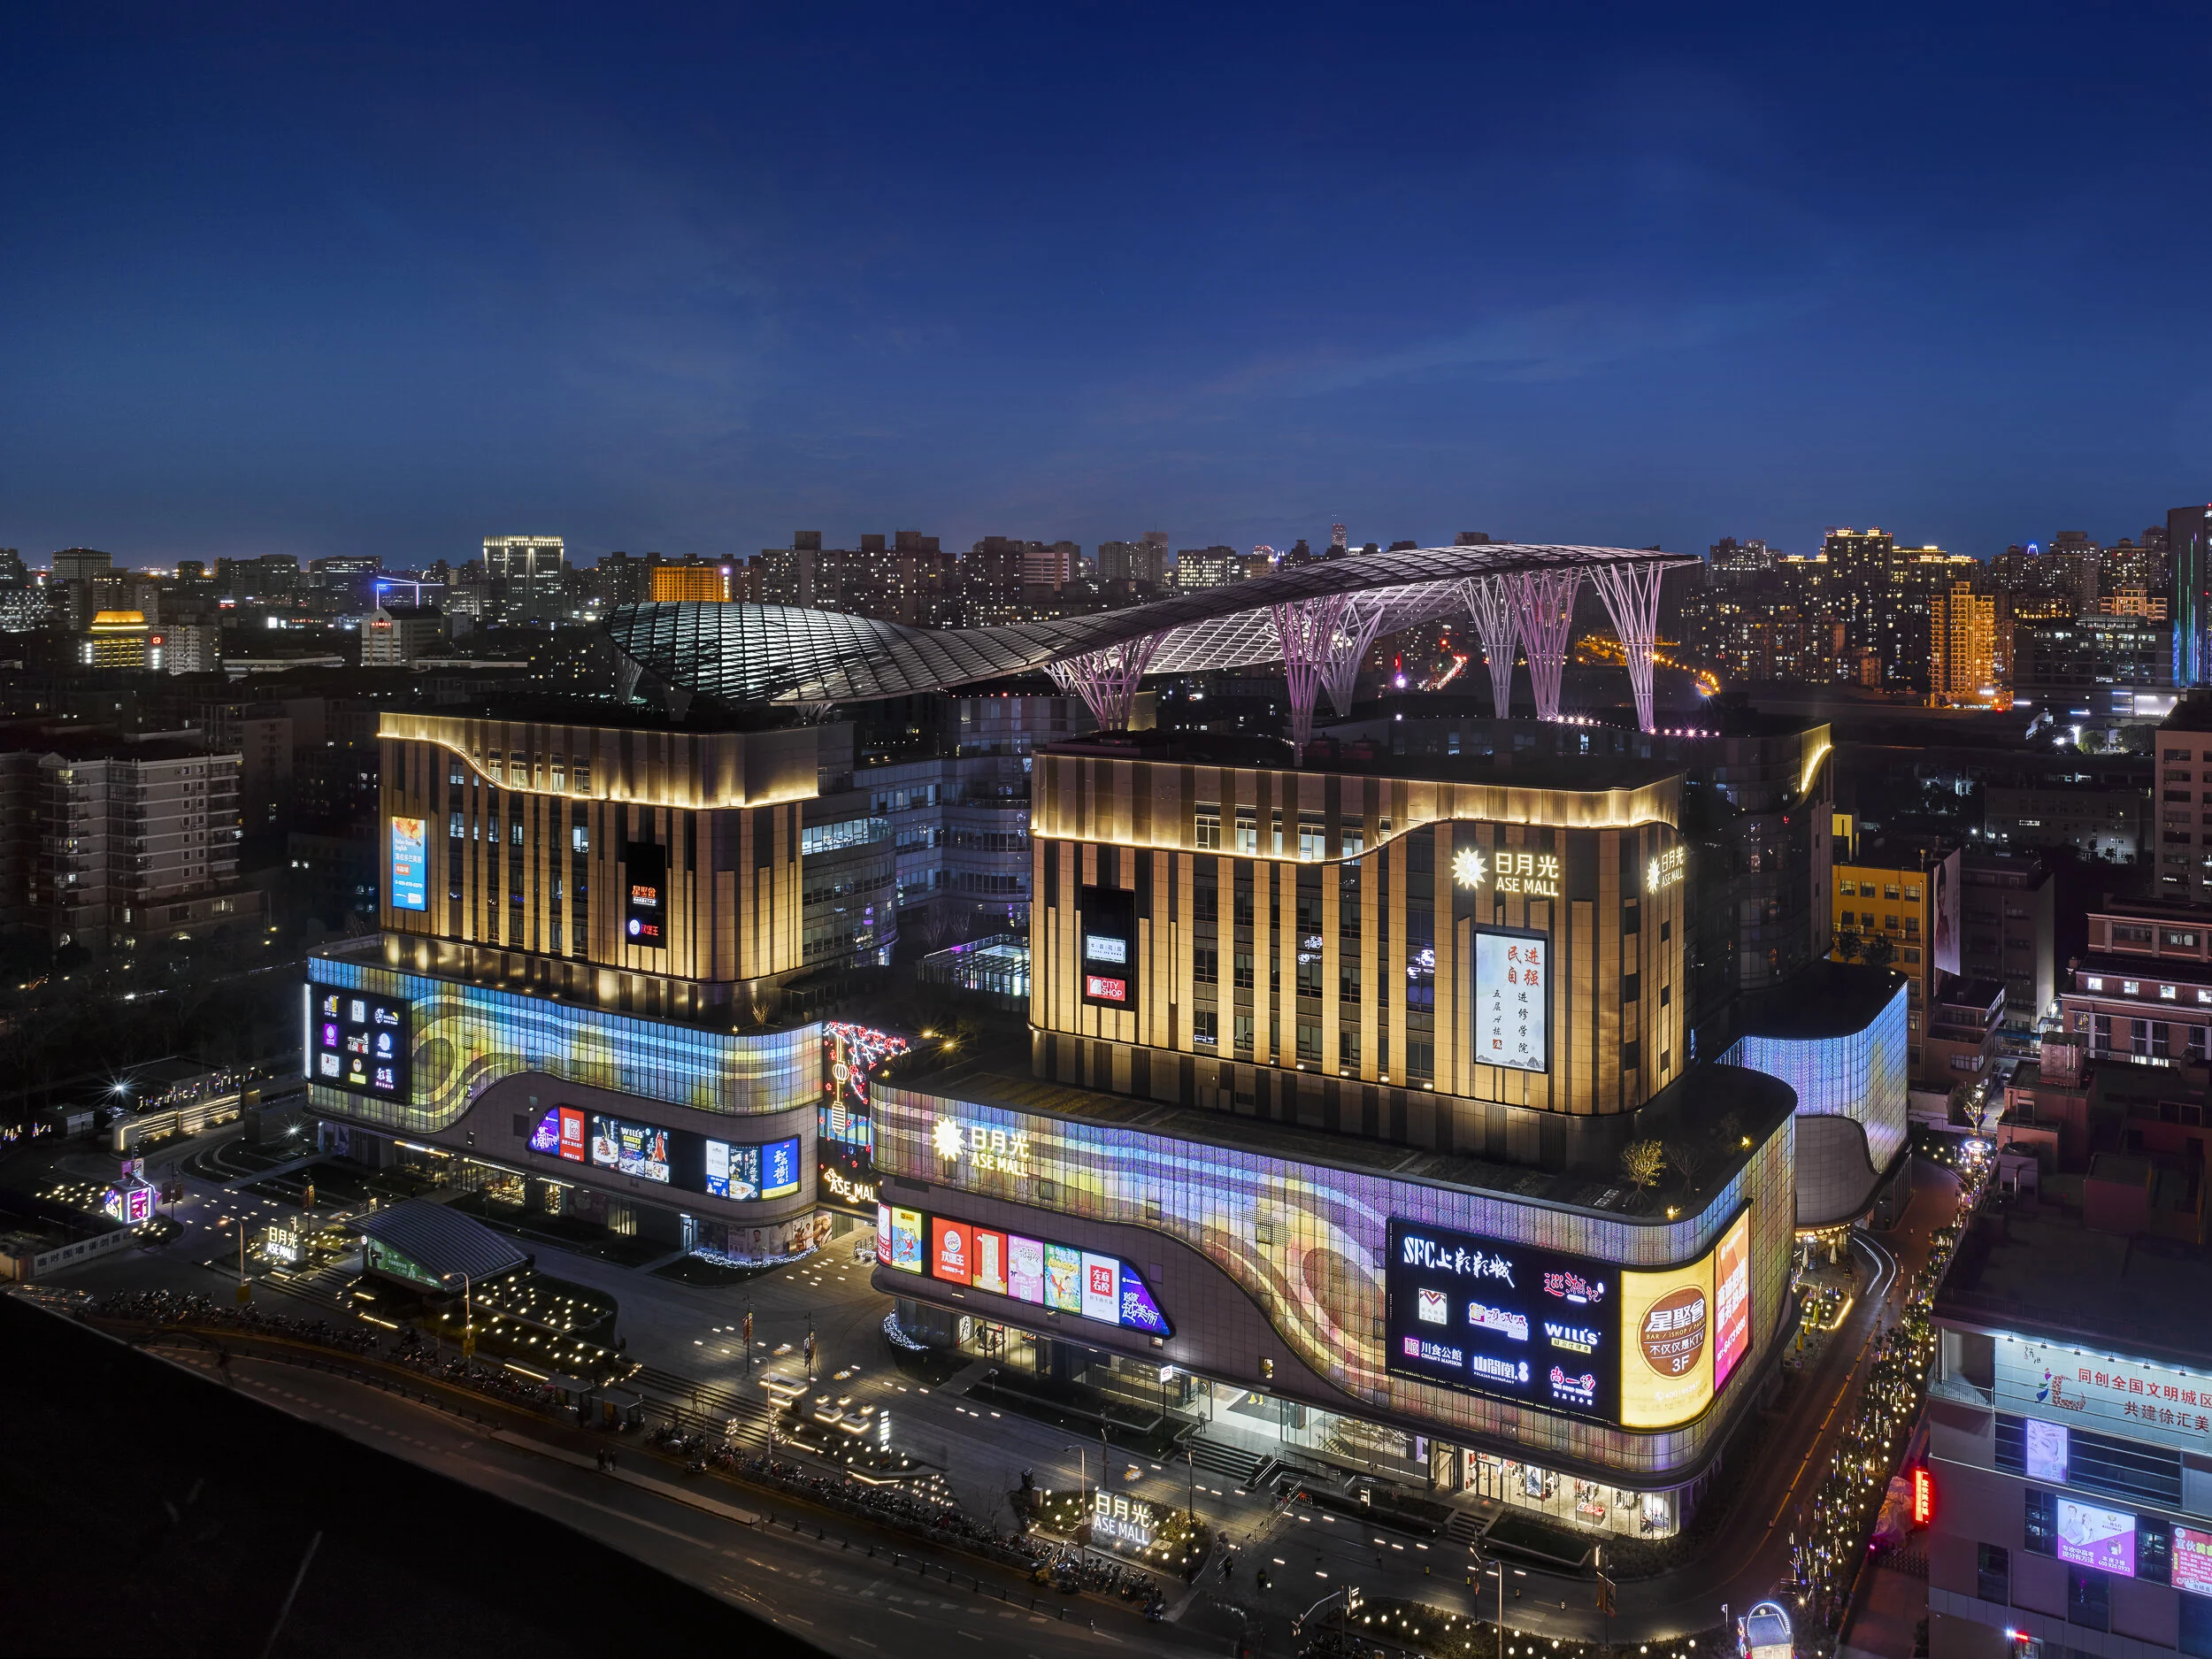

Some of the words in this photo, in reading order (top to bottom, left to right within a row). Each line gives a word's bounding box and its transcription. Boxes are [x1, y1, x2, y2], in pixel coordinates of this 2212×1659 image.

[1496, 853, 1558, 878] 日月光
[1662, 847, 1684, 872] 日月光
[1496, 878, 1519, 892] ASE
[1524, 879, 1558, 896] MALL
[1662, 872, 1671, 887] ASE
[1671, 867, 1683, 884] MALL
[1101, 979, 1119, 990] CITY
[1101, 988, 1123, 998] SHOP
[1517, 992, 1529, 1054] 进修学院
[971, 1125, 1029, 1158] 日月光
[972, 1152, 995, 1170] ASE
[997, 1157, 1029, 1178] MALL
[829, 1178, 851, 1195] ASE
[854, 1184, 879, 1202] MAL
[269, 1226, 298, 1248] 日月光
[267, 1242, 280, 1256] ASE
[280, 1245, 296, 1261] MALL
[941, 1250, 964, 1266] 汉堡王
[1404, 1237, 1434, 1269] SFC
[1645, 1298, 1705, 1333] 星聚會
[1649, 1330, 1704, 1356] 不仅仅是KTV
[1441, 1357, 1462, 1367] MANSION
[1672, 1355, 1690, 1372] 3F
[2078, 1368, 2212, 1409] 同创全国文明城区
[2124, 1402, 2209, 1432] 共建徐汇美
[1096, 1493, 1149, 1528] 日月光
[1094, 1516, 1116, 1534] ASE
[1118, 1522, 1149, 1547] MALL
[2193, 1583, 2212, 1593] 电梯直
